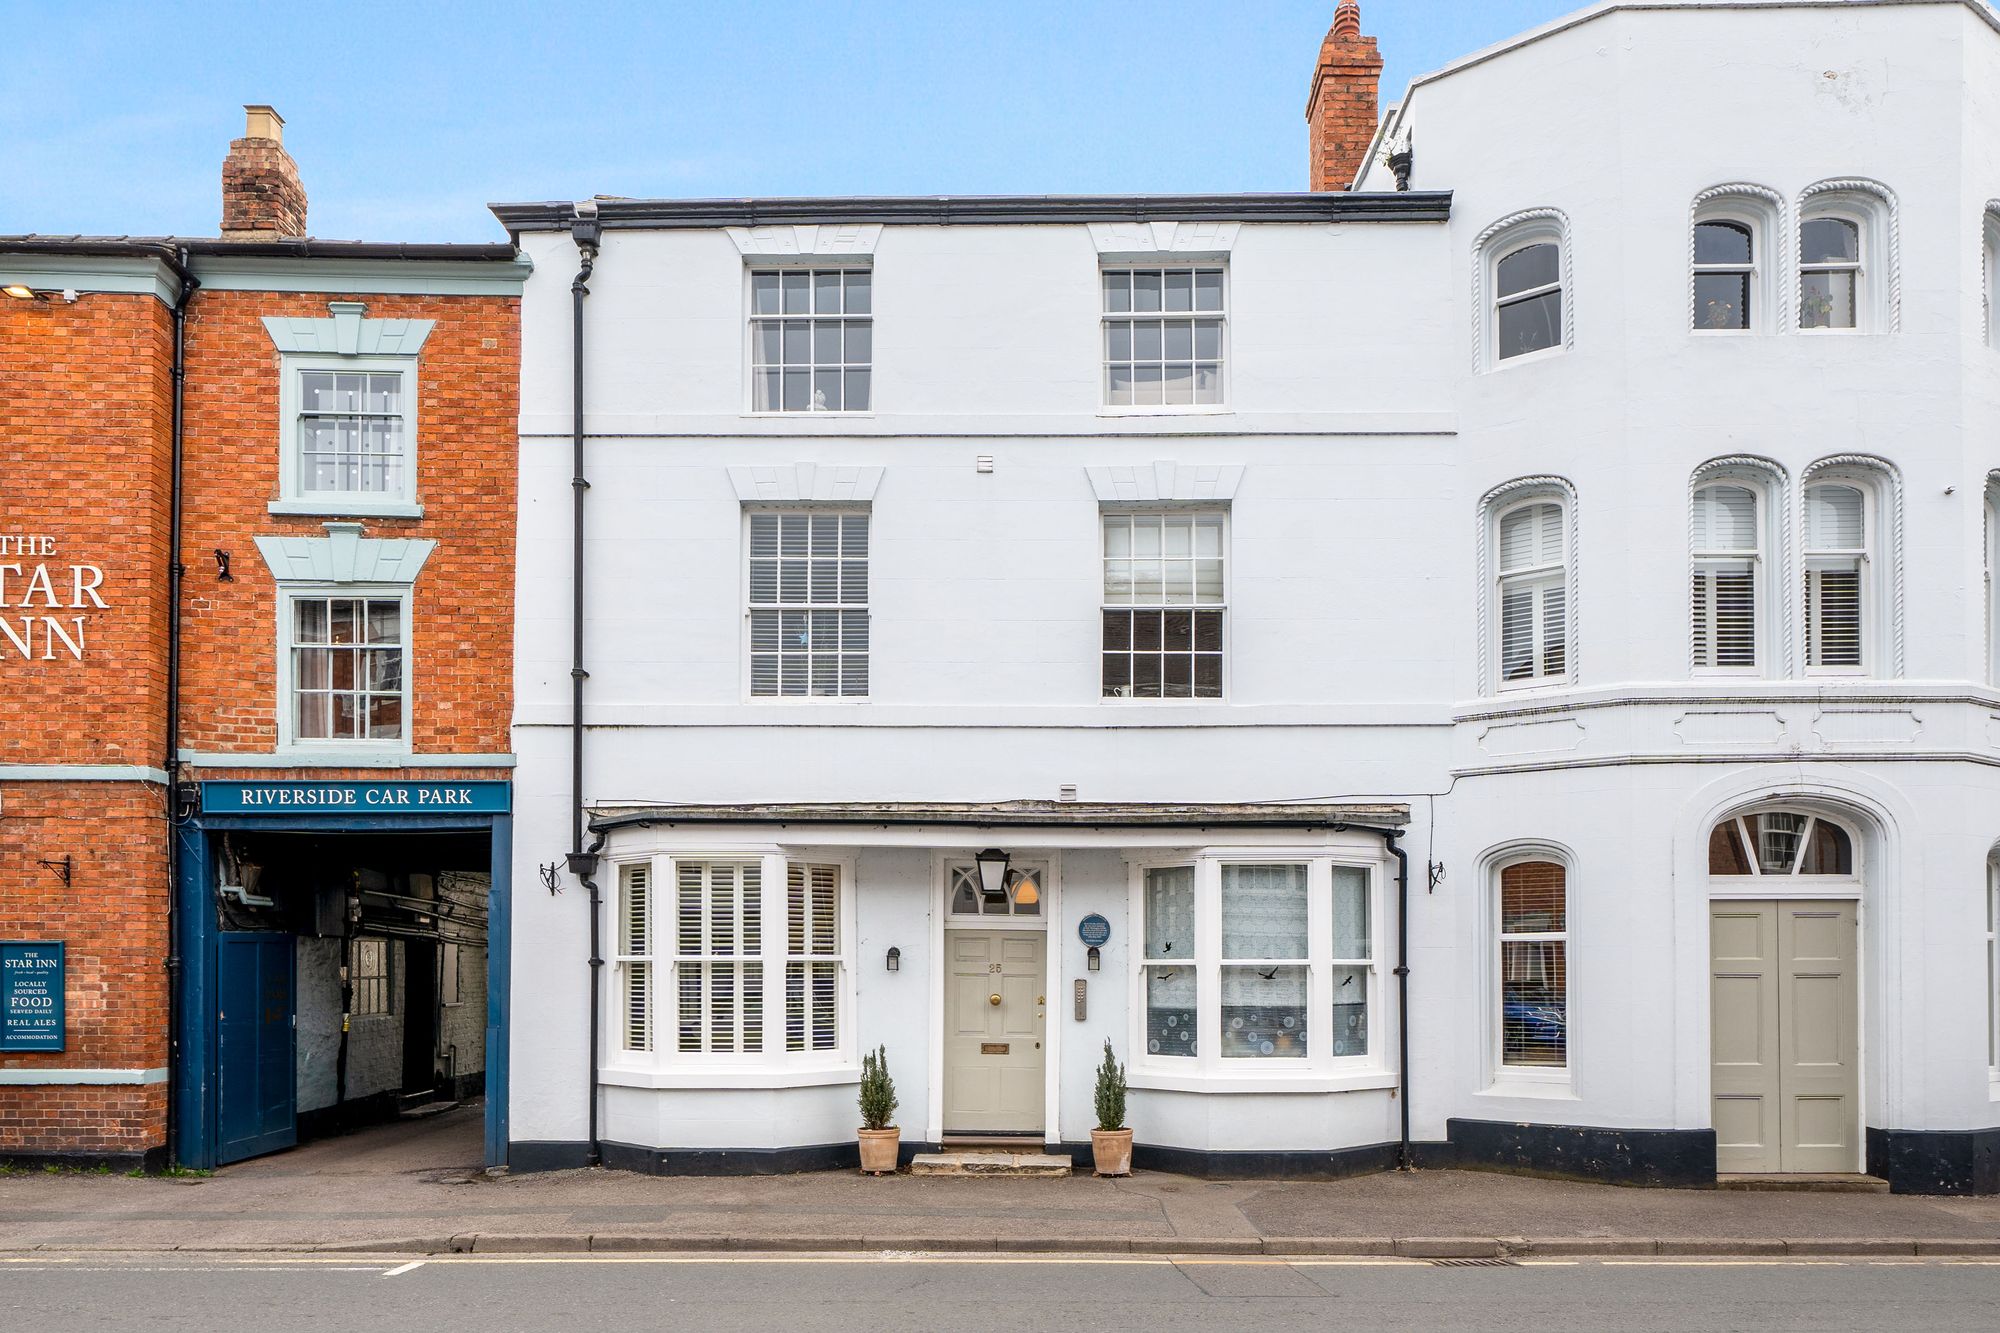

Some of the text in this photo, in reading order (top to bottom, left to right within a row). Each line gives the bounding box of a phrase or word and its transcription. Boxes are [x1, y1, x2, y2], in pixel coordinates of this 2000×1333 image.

[0, 535, 57, 556] THE
[241, 789, 472, 804] RIVERSIDE CAR PARK
[5, 959, 57, 968] STAR INN
[989, 963, 1002, 974] 25
[11, 997, 52, 1007] FOOD
